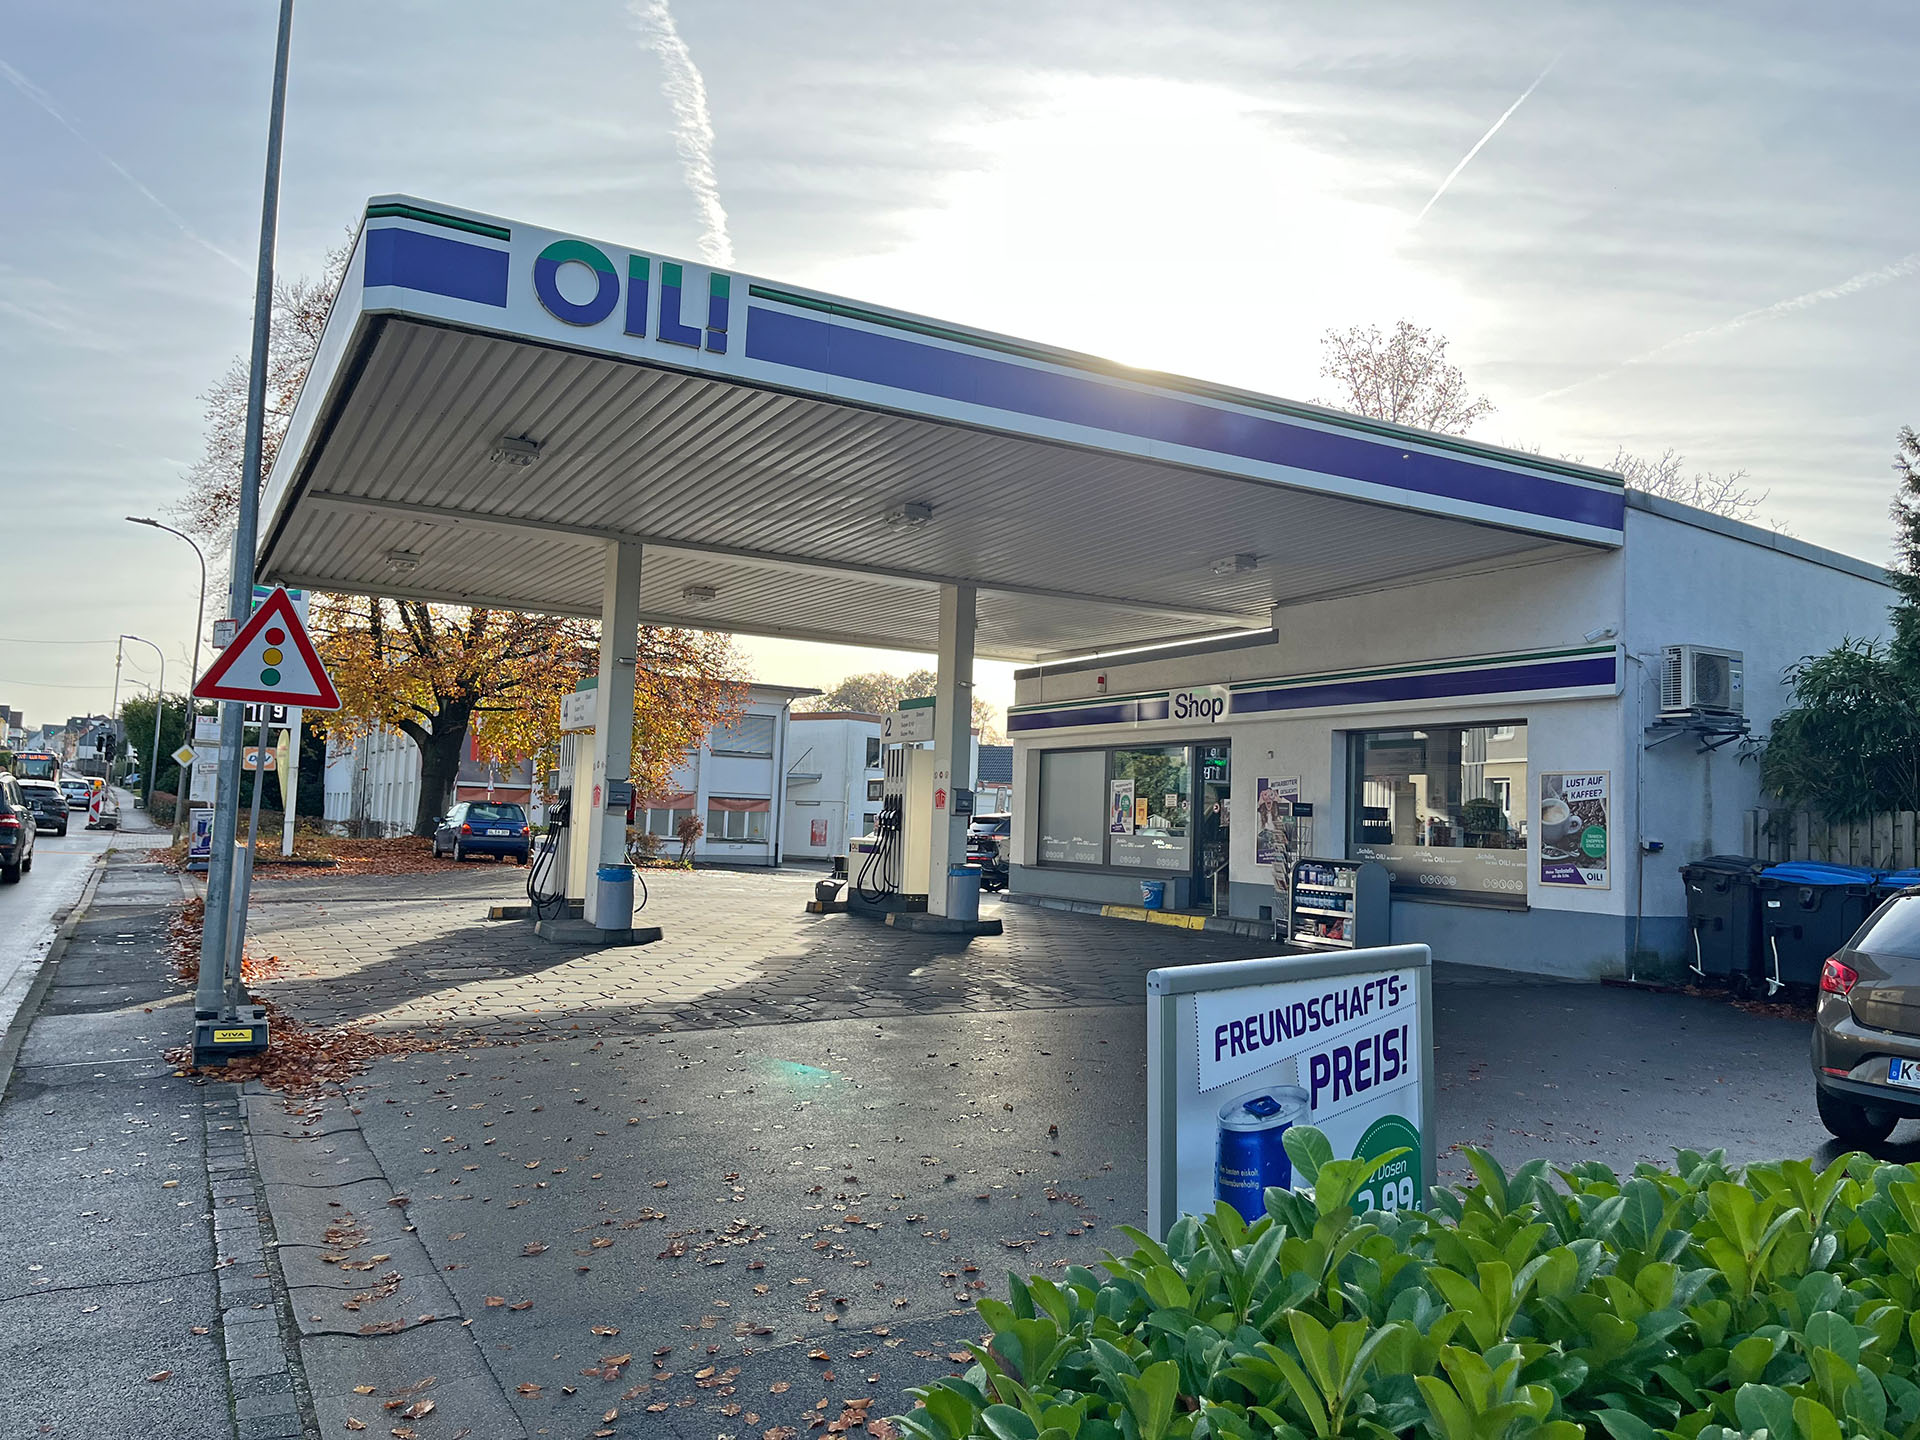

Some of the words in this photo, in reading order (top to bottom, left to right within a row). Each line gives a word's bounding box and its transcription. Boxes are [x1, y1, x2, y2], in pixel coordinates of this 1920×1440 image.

[532, 239, 730, 354] OIL!
[563, 700, 569, 722] 4
[1174, 692, 1224, 723] Shop
[885, 717, 892, 737] 2
[1566, 778, 1586, 788] LUST
[1587, 776, 1603, 786] AUF
[1571, 789, 1603, 799] KAFFEE?
[1586, 872, 1603, 881] OIL!
[1215, 975, 1408, 1062] FREUNDSCHAFTS-
[1310, 1025, 1408, 1110] PREIS!
[1378, 1160, 1406, 1180] Dosen
